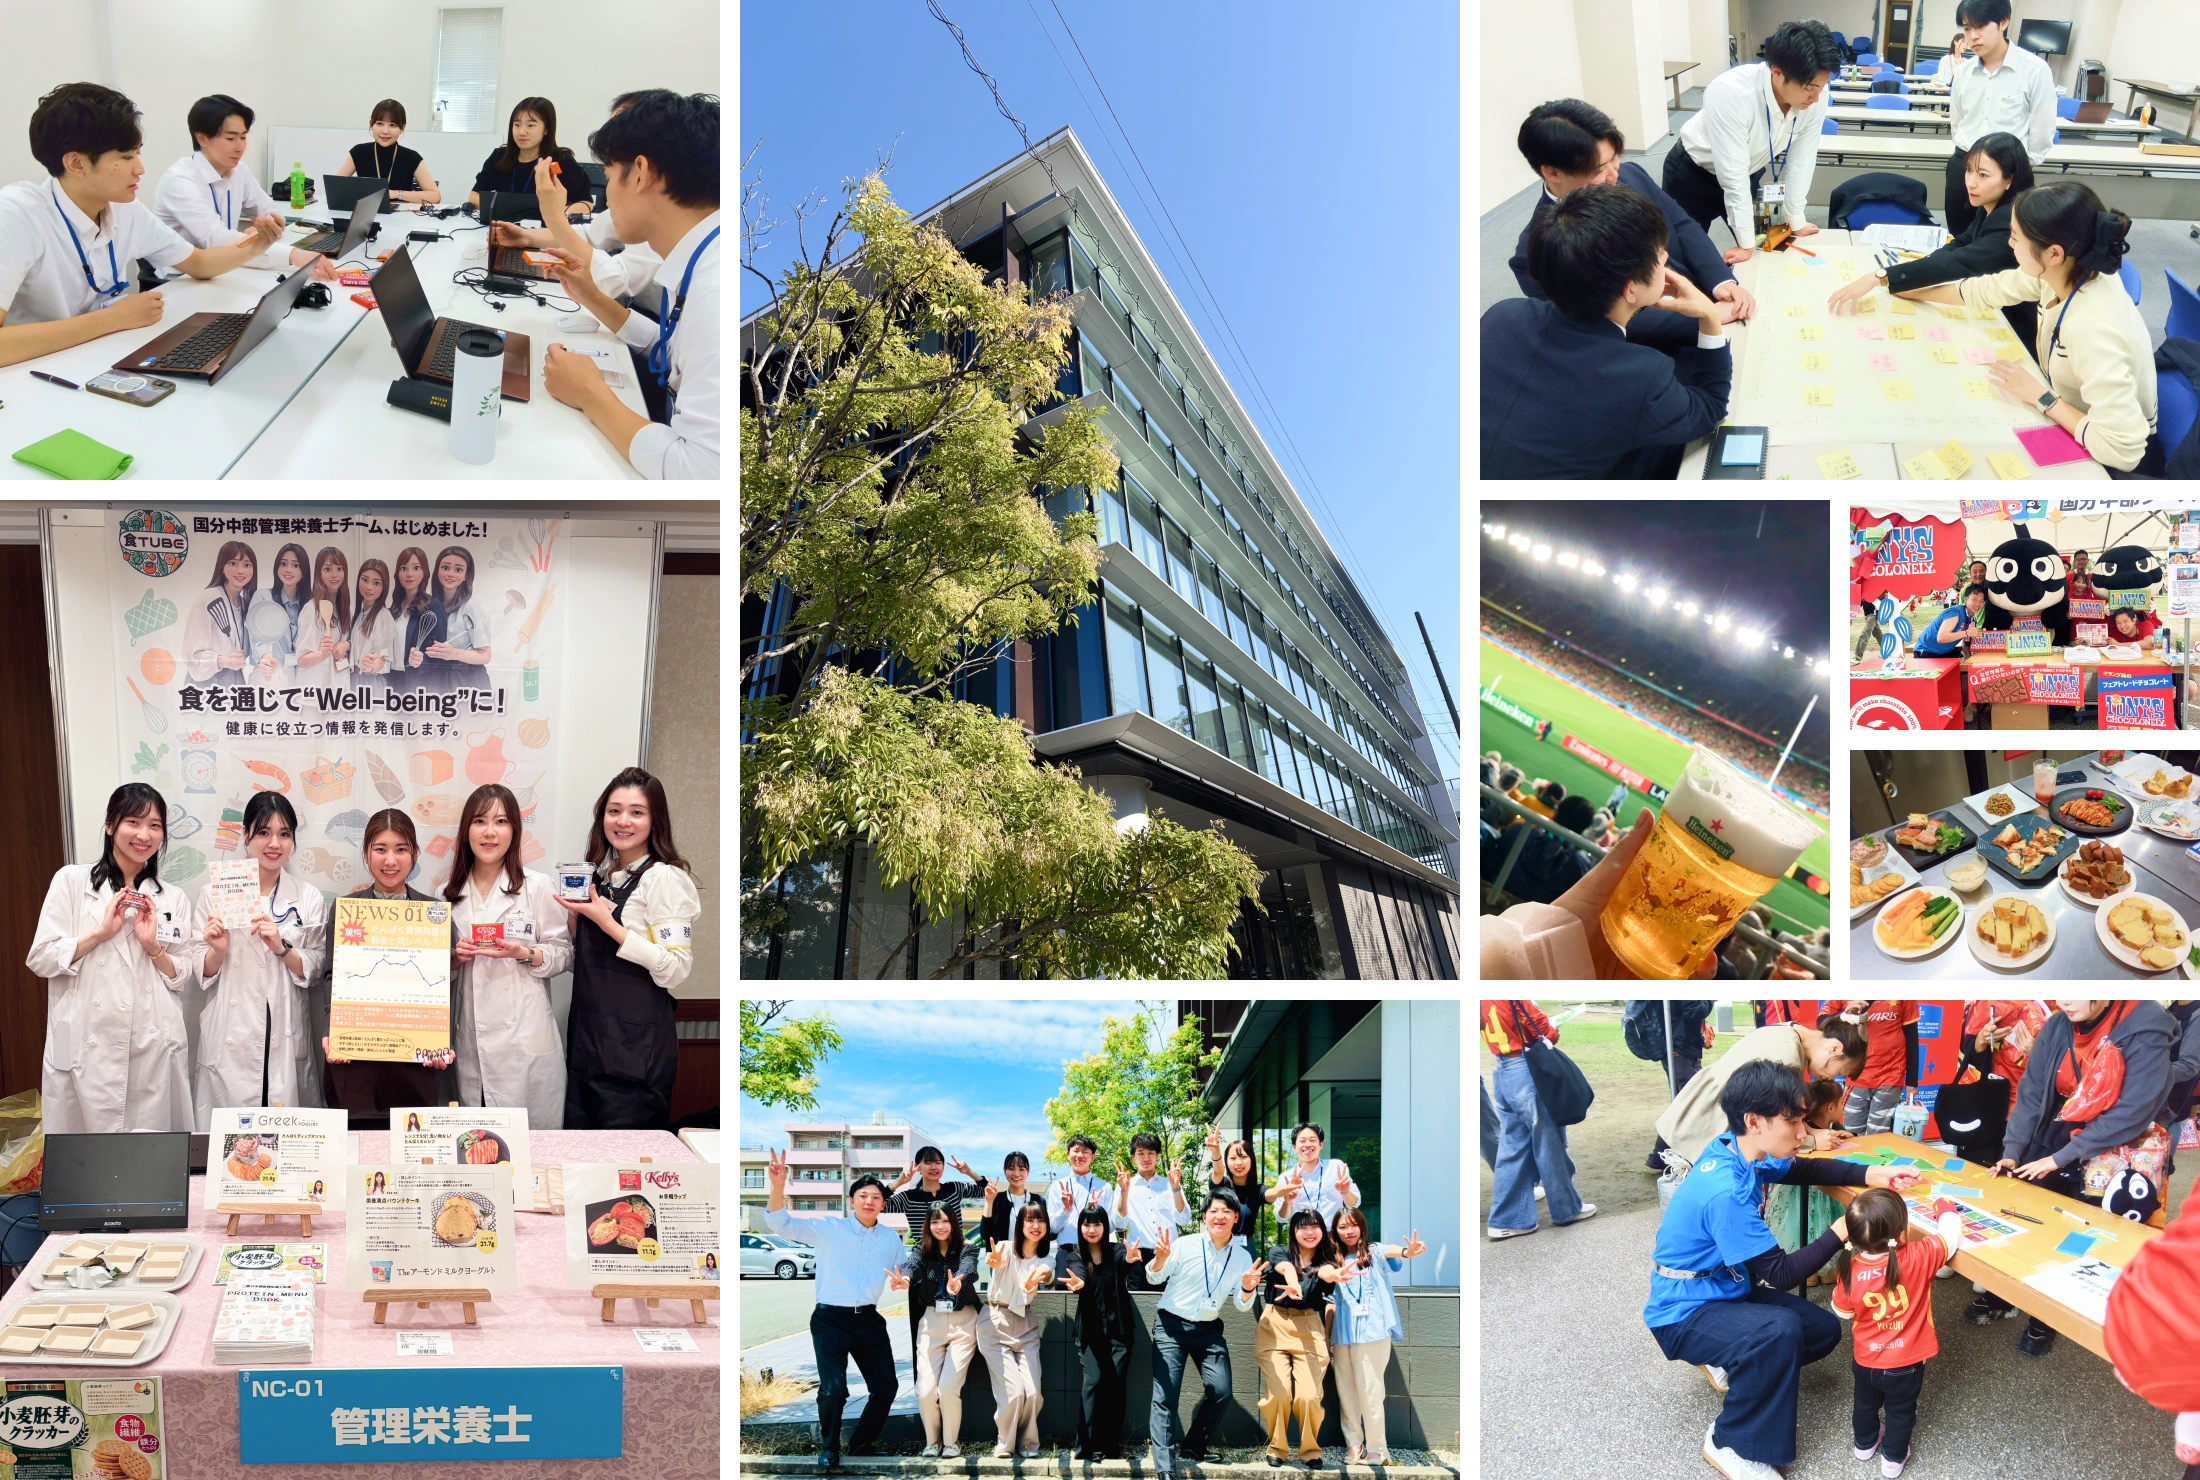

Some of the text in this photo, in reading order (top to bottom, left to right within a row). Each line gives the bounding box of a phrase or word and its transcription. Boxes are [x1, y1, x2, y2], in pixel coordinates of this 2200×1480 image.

[193, 516, 487, 538] 国分中部管理栄養士チーム、はじめました！
[2029, 674, 2079, 693] TONY'S
[2102, 678, 2169, 689] フェアトレードチョコレート
[1481, 687, 1535, 729] Heineken
[2105, 694, 2164, 719] TONY'S
[225, 720, 460, 737] 健康に役立つ情報を発信します。
[1568, 738, 1609, 768] Emirates
[1688, 818, 1730, 858] Heineken
[339, 904, 423, 922] NEWS 01
[259, 1115, 298, 1127] Greek
[645, 1171, 681, 1189] Kelly's
[252, 1379, 324, 1398] NC-01
[0, 1406, 80, 1426] 小麦胚芽の
[119, 1418, 140, 1428] 食物
[9, 1425, 70, 1441] クラッカー
[119, 1428, 141, 1437] 繊維
[330, 1405, 533, 1446] 管理栄養士
[140, 1438, 159, 1446] 鉄分
